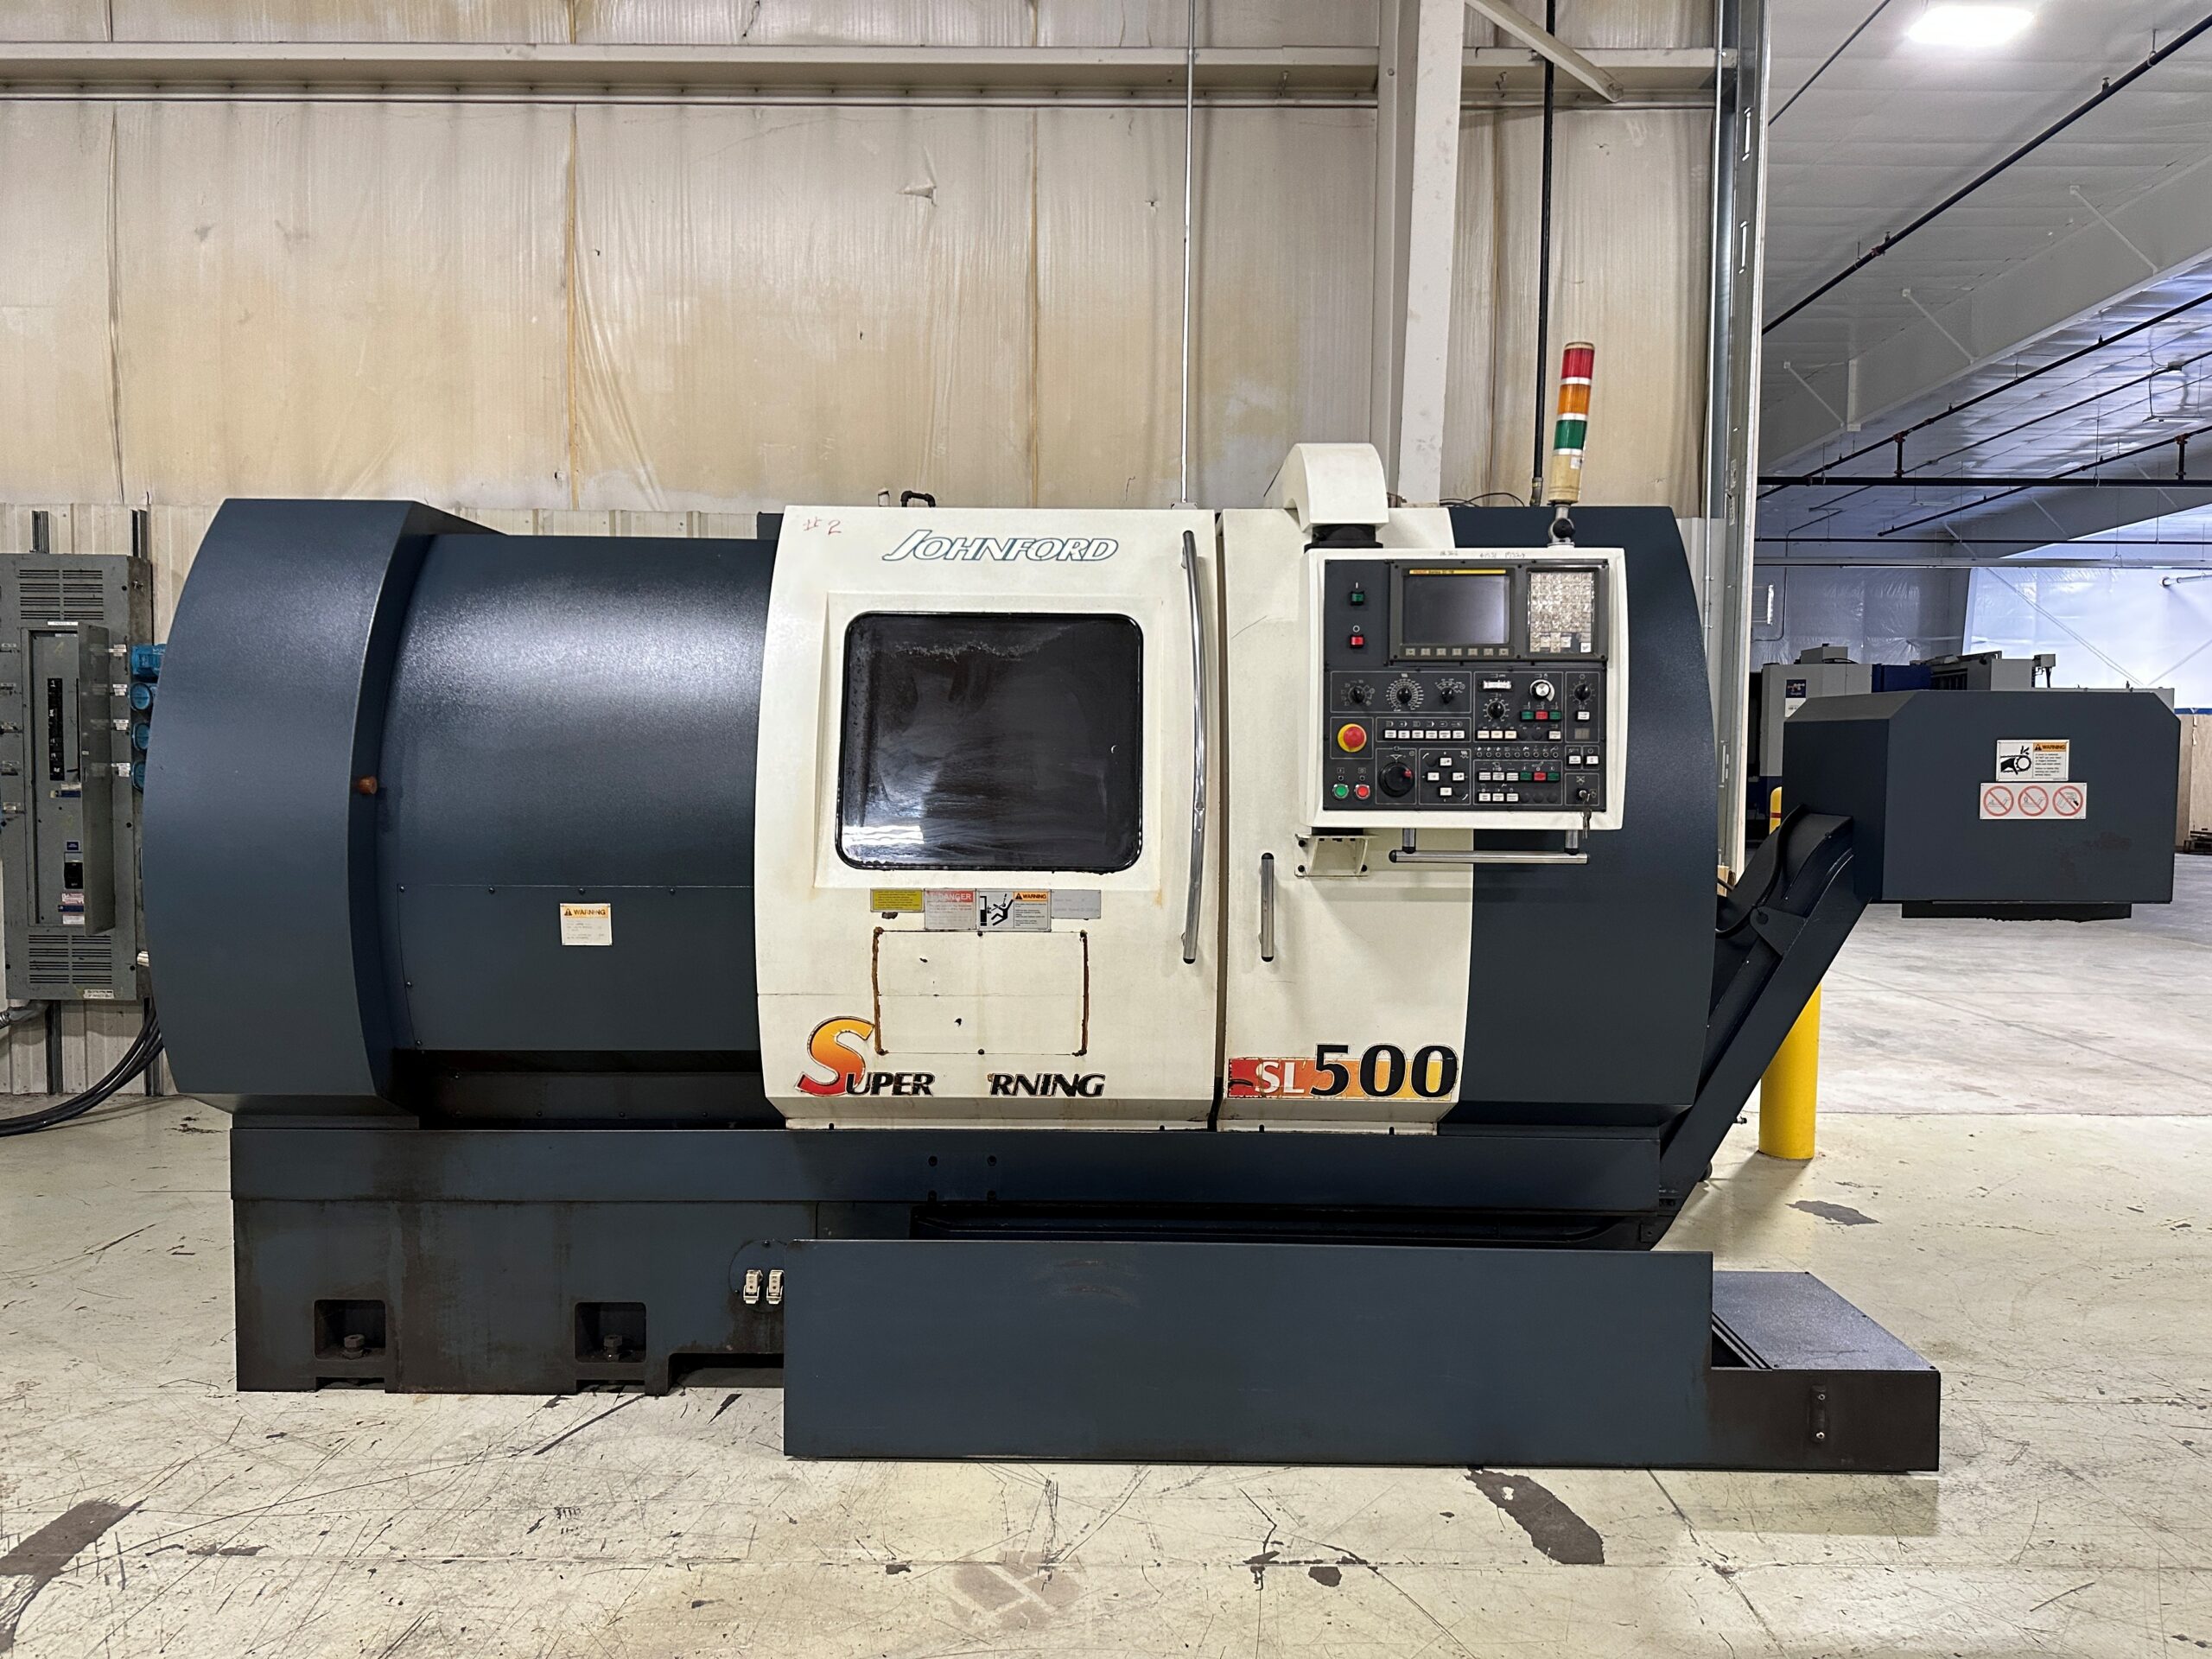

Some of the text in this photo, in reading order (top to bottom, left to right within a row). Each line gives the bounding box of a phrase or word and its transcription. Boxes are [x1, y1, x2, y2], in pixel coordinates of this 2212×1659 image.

[882, 529, 1118, 562] JOHNFORD
[795, 1015, 1106, 1097] SUPER RNING
